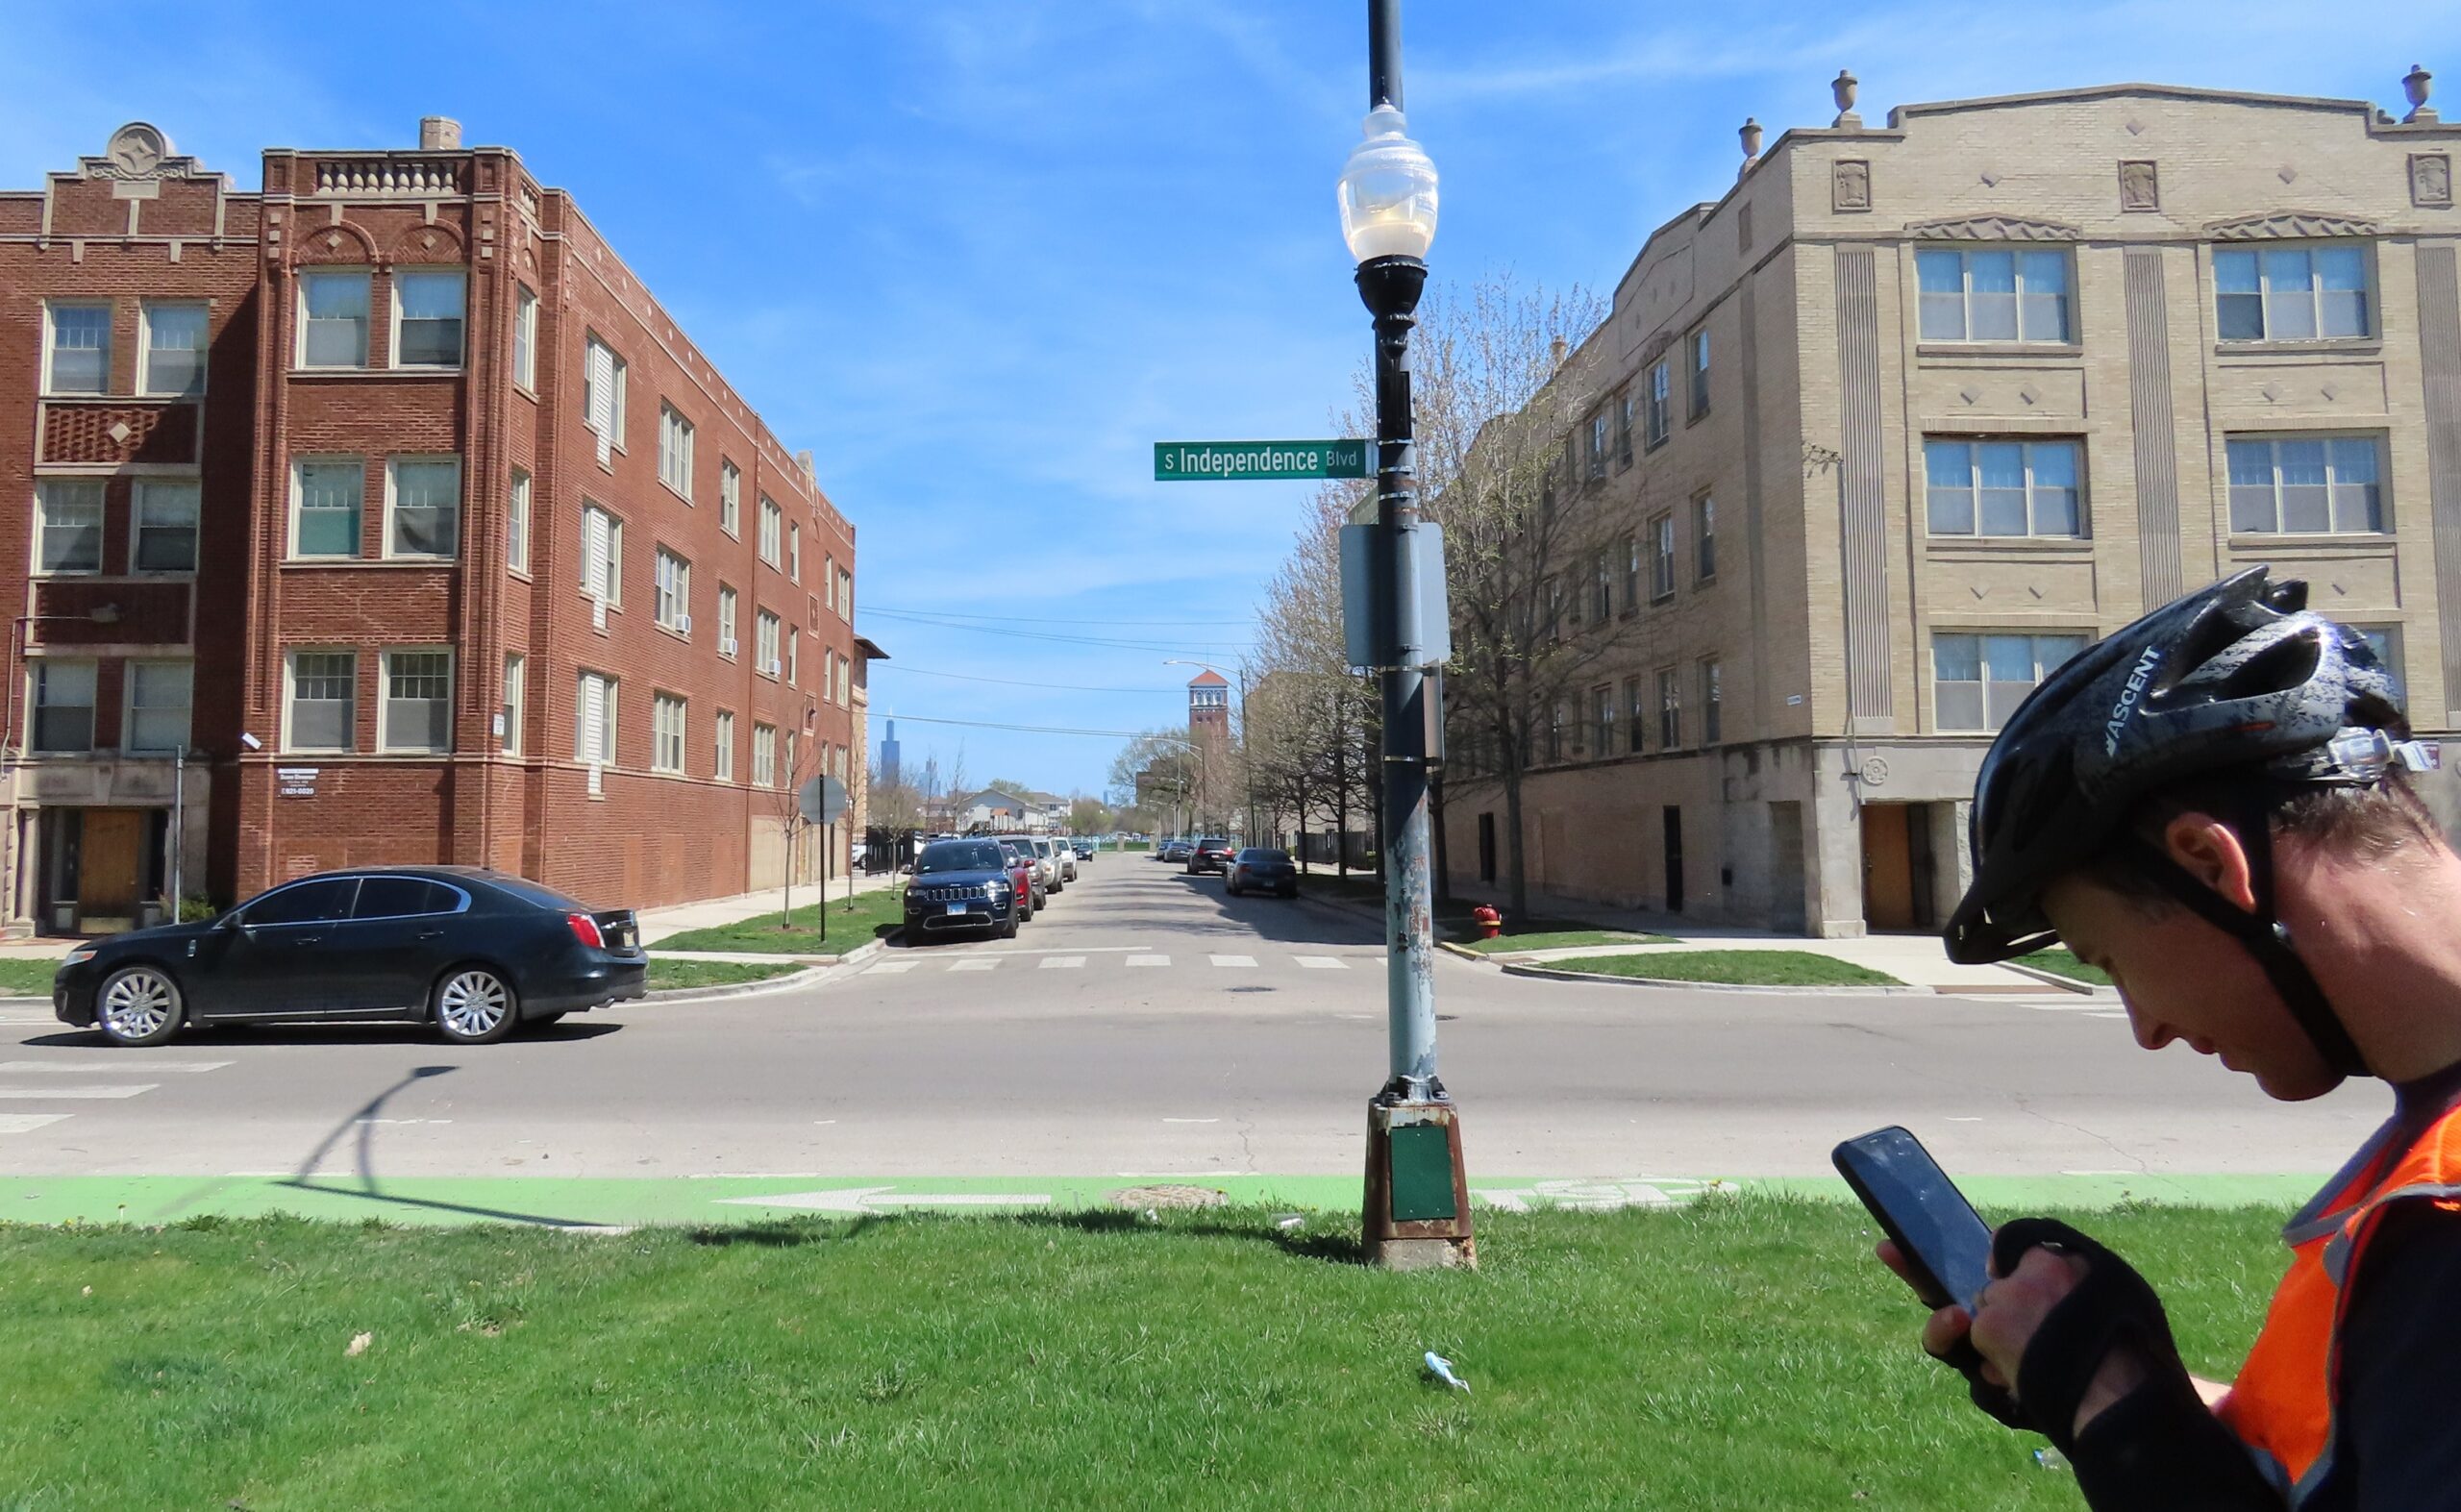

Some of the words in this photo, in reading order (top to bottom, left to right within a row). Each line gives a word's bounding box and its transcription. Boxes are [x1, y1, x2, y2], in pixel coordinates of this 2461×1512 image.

[1164, 453, 1175, 470] S
[1181, 446, 1318, 478] Independence
[1326, 451, 1357, 467] Blvd
[2106, 645, 2160, 739] ASCENT
